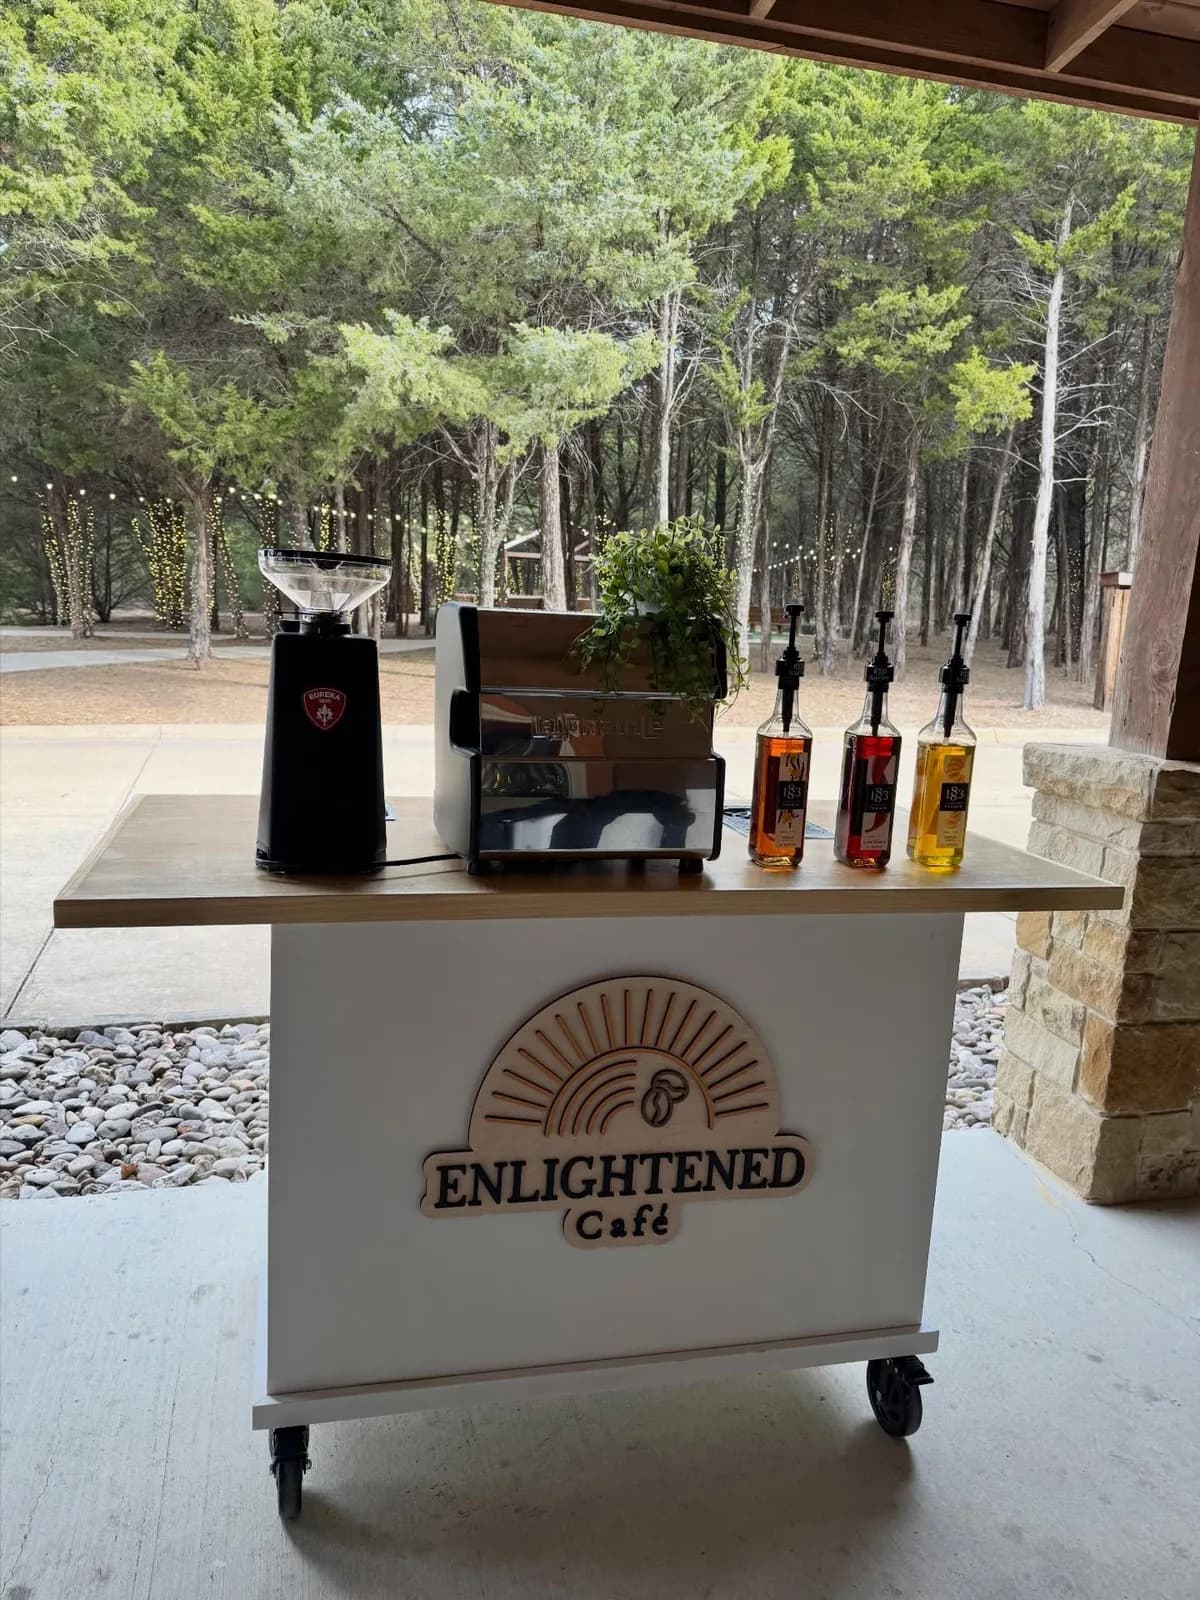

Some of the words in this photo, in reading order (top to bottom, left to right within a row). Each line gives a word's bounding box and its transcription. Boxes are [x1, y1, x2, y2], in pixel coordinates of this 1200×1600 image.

[308, 691, 340, 701] EUREKA
[434, 1147, 806, 1209] ENLIGHTENED
[575, 1203, 670, 1240] Café
